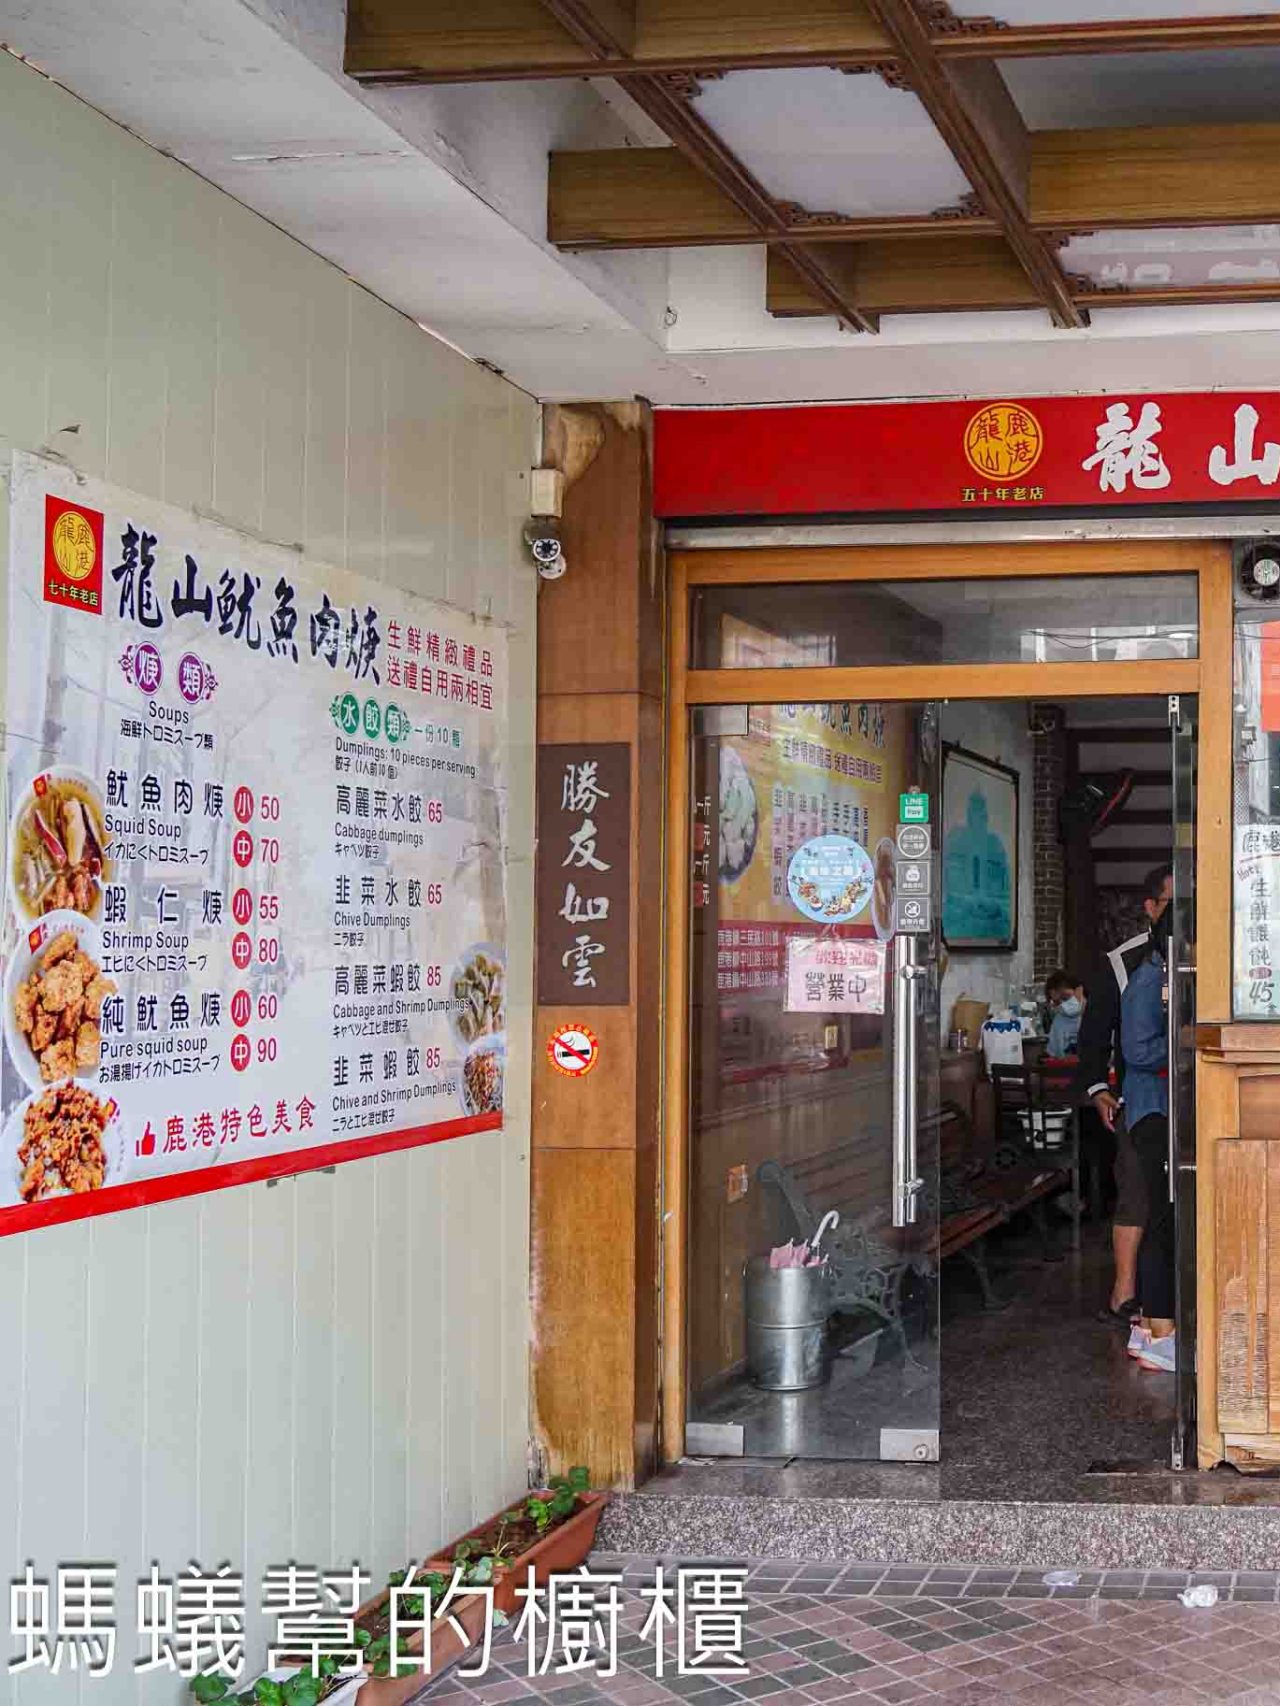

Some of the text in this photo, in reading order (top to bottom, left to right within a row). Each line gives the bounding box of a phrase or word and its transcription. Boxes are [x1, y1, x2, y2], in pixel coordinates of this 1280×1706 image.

[961, 486, 1044, 502] 五十年老店
[48, 578, 98, 606] 七十年老店
[387, 619, 493, 677] 生鮮精緻禮品
[388, 654, 493, 710] 送禮自用兩相宜
[149, 700, 190, 726] Soups
[391, 748, 400, 762] 10
[402, 752, 430, 768] pieces
[431, 758, 446, 773] per
[447, 760, 476, 778] serving
[261, 796, 280, 821] 50
[336, 785, 442, 824] 高麗菜水餃 65
[105, 814, 182, 840] Squid Soup
[335, 822, 424, 848] Cabbage dumplings
[261, 838, 280, 863] 70
[558, 761, 611, 988] 勝友如雲
[427, 883, 442, 905] 65
[259, 895, 279, 920] 55
[334, 911, 411, 933] Chive Dumplings
[102, 931, 189, 952] Shrimp Soup
[259, 938, 278, 963] 80
[335, 963, 441, 996] 高麗菜蝦餃 85
[805, 971, 867, 1002] 營業中
[1249, 981, 1275, 1004] 45
[258, 995, 278, 1019] 60
[333, 997, 471, 1022] Cabbage and Shrimp Dumplings
[100, 1036, 208, 1059] Pure squid soup
[257, 1037, 277, 1062] 90
[426, 1047, 441, 1069] 85
[332, 1081, 456, 1112] Chive and Shrimp Dumplings
[163, 1095, 315, 1154] 鹿港特色美食
